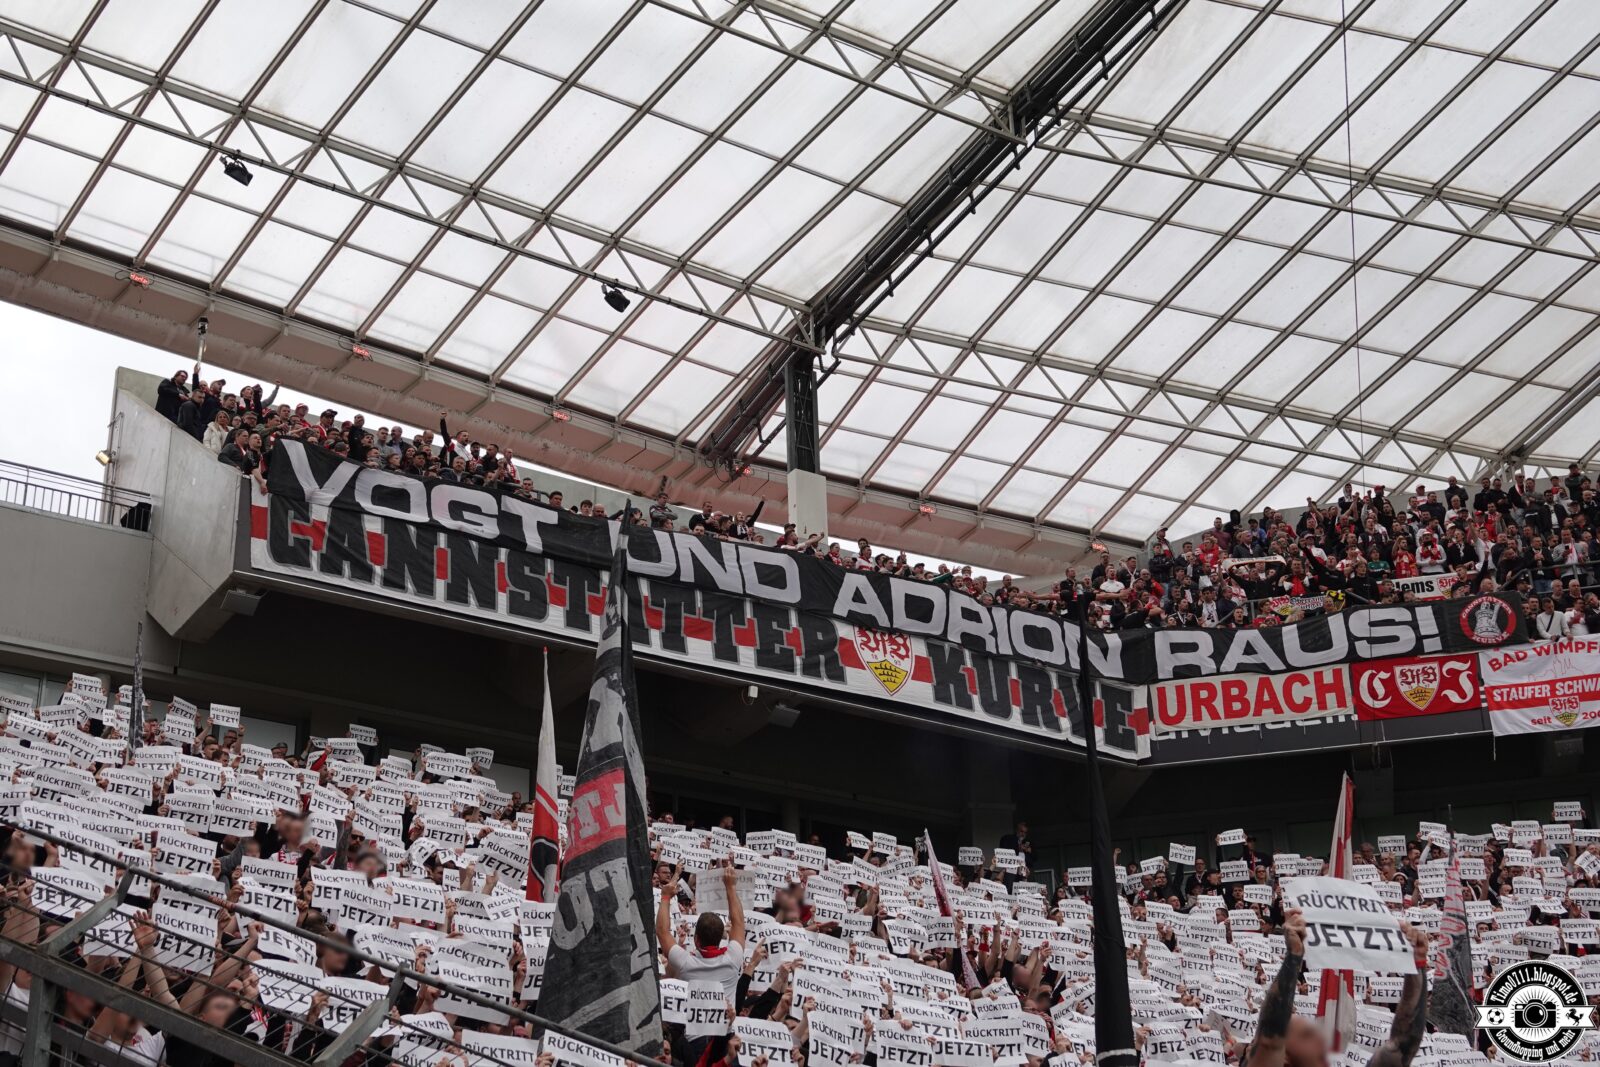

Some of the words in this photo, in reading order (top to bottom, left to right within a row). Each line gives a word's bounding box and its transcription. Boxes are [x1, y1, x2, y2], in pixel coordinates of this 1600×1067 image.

[607, 519, 801, 602] UND
[832, 572, 1123, 679] ADRION
[1154, 605, 1443, 680] RAUS!
[1487, 650, 1528, 672] BAD
[1156, 668, 1350, 726] URBACH
[1493, 684, 1550, 703] STAUFER
[41, 708, 76, 717] RÜCKTRITT
[171, 705, 195, 720] JETZT!
[211, 706, 240, 716] RÜCKTRITT
[211, 714, 239, 724] JETZT!
[1531, 715, 1552, 726] seit
[7, 720, 48, 740] JETZT!
[165, 725, 195, 738] JETZT!
[60, 729, 99, 750] RÜCKTRITT
[134, 751, 174, 759] RÜCKTRITT
[180, 758, 222, 772] RÜCKTRITT
[342, 767, 375, 776] RÜCKTRITT
[426, 762, 455, 773] JETZT!
[36, 773, 82, 790] RÜCKTRITT
[109, 772, 152, 784] RÜCKTRITT
[180, 766, 221, 783] JETZT!
[108, 782, 151, 798] JETZT!
[371, 785, 405, 796] RÜCKTRITT
[165, 799, 212, 811] RÜCKTRITT
[311, 798, 350, 818] JETZT!
[371, 793, 405, 808] JETZT!
[24, 806, 79, 825] RÜCKTRITT
[63, 801, 109, 819] RÜCKTRITT
[1555, 810, 1581, 818] JETZT!
[82, 822, 134, 836] RÜCKTRITT
[136, 819, 187, 833] RÜCKTRITT
[427, 819, 466, 830] RÜCKTRITT
[59, 830, 116, 854] RÜCKTRITT
[425, 829, 463, 844] JETZT!
[160, 836, 214, 856] RÜCKTRITT
[796, 847, 825, 856] RÜCKTRITT
[1379, 845, 1405, 853] JETZT!
[682, 849, 712, 859] RÜCKTRITT
[796, 853, 825, 866] JETZT!
[1169, 851, 1195, 862] JETZT!
[155, 850, 212, 875] JETZT!
[479, 853, 525, 882] JETZT!
[755, 861, 787, 872] RÜCKTRITT
[244, 864, 296, 881] RÜCKTRITT
[1221, 870, 1248, 879] JETZT!
[392, 881, 443, 895] RÜCKTRITT
[243, 891, 297, 915] JETZT!
[344, 891, 392, 910] RÜCKTRITT
[394, 893, 444, 914] JETZT!
[1244, 892, 1272, 900] JETZT!
[340, 904, 391, 927] JETZT!
[961, 909, 996, 920] JETZT!
[1230, 918, 1259, 926] JETZT!
[155, 913, 215, 938] RÜCKTRITT
[458, 925, 513, 940] RÜCKTRITT
[1020, 929, 1054, 940] JETZT!
[1306, 922, 1408, 953] JETZT!
[1563, 931, 1598, 939] JETZT!
[1519, 939, 1552, 949] JETZT!
[438, 946, 506, 969] RÜCKTRITT
[443, 968, 511, 988] RÜCKTRITT
[814, 1001, 863, 1020] RÜCKTRITT
[977, 1002, 1019, 1013] RÜCKTRITT
[687, 1007, 728, 1024] JETZT!
[737, 1023, 791, 1042] RÜCKTRITT
[965, 1027, 1021, 1038] RÜCKTRITT
[547, 1036, 621, 1066] RÜCKTRITT
[880, 1045, 933, 1067] JETZT!
[936, 1041, 990, 1057] JETZT!
